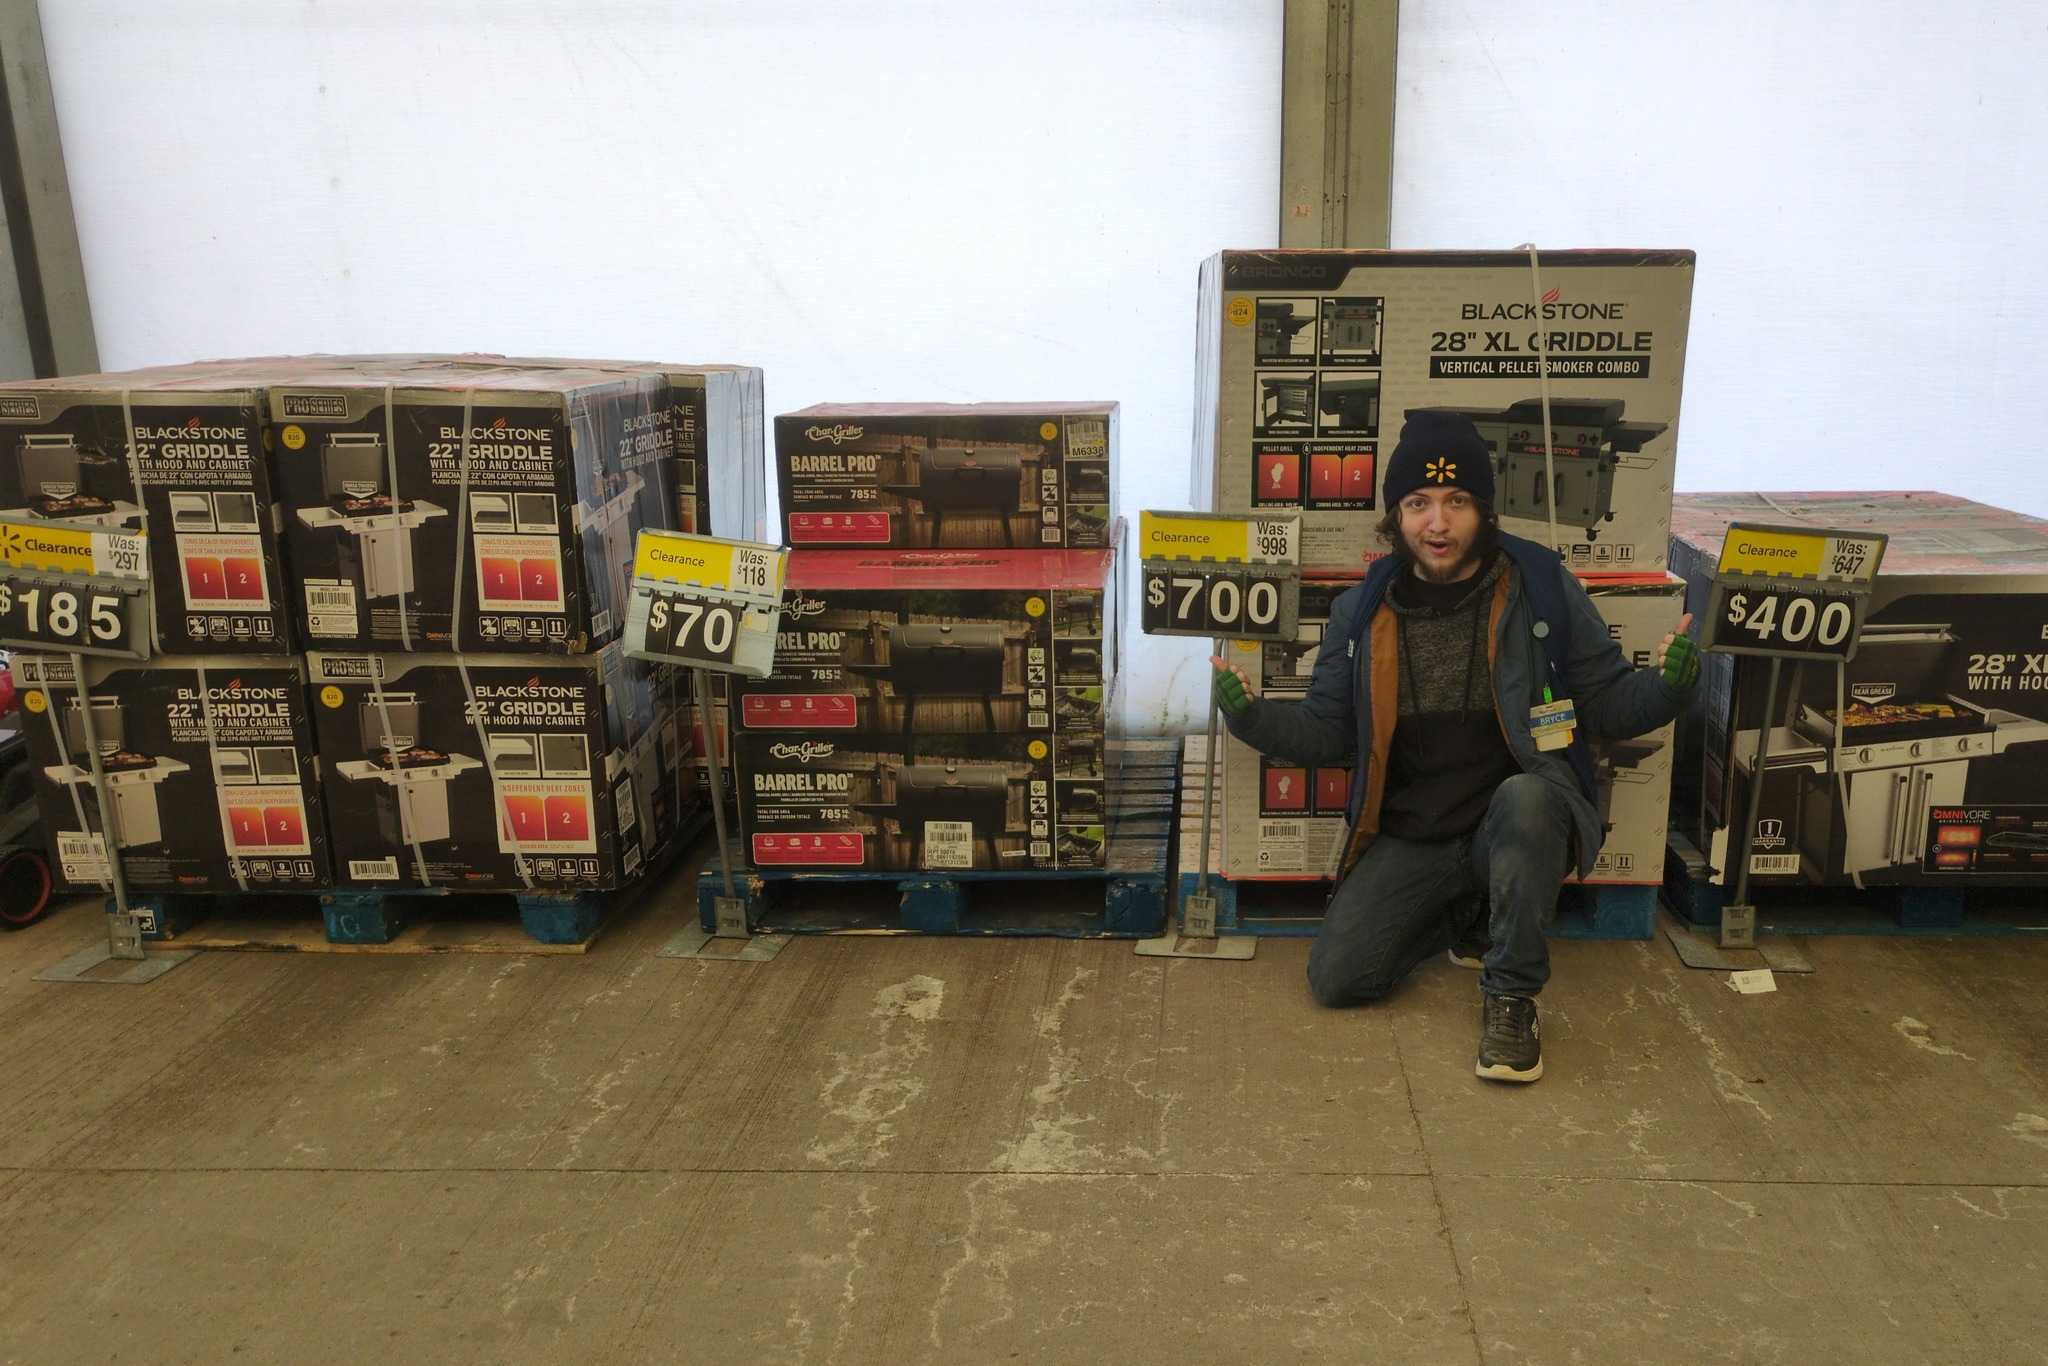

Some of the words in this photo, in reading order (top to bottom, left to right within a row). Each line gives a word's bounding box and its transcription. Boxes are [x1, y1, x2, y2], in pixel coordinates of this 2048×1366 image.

[1242, 266, 1326, 278] BRONCO
[1461, 303, 1624, 320] BLACKSTONE
[1431, 331, 1477, 351] 28"
[1484, 332, 1520, 351] XL
[1528, 332, 1653, 352] GRIDDLE
[1440, 361, 1495, 374] VERTICAL
[1498, 361, 1541, 374] PELLET
[1546, 361, 1593, 374] SMOKER
[1597, 361, 1640, 374] COMBO
[2, 400, 37, 418] SERIES
[286, 400, 309, 414] PRO
[310, 400, 344, 414] SERIES
[624, 410, 671, 432] BLACKSTONE
[135, 427, 247, 440] BLACKSTONE
[635, 428, 673, 453] GRIDDLE
[805, 424, 864, 445] Char-Griller
[125, 444, 156, 458] 22"
[162, 444, 249, 459] GRIDDLE
[428, 443, 460, 458] 22"
[468, 444, 553, 460] GRIDDLE
[1531, 446, 1580, 456] BLACSTONE
[127, 460, 152, 469] WTH
[156, 460, 183, 469] HOOD
[186, 460, 206, 470] AND
[209, 460, 250, 470] CABINET
[430, 459, 455, 469] WITH
[489, 460, 509, 470] AND
[512, 461, 554, 471] CABINET
[791, 456, 846, 472] BARREL
[224, 472, 252, 480] ARMARIO
[1324, 470, 1329, 480] 1
[1354, 470, 1360, 480] 2
[850, 490, 870, 499] 785
[1152, 531, 1210, 544] Clearance
[1257, 522, 1288, 536] Was:
[25, 538, 92, 556] Clearance
[108, 535, 139, 551] Was:
[1257, 537, 1287, 556] $998
[1600, 547, 1606, 555] 6
[1738, 543, 1798, 558] Clearance
[1836, 540, 1868, 555] Was:
[108, 552, 139, 571] $297
[650, 549, 705, 567] Clearance
[740, 549, 768, 566] Was:
[1832, 555, 1864, 575] $647
[203, 573, 208, 584] 1
[240, 573, 247, 584] 2
[499, 573, 504, 584] 1
[536, 574, 543, 585] 2
[737, 565, 766, 587] $118
[1148, 577, 1278, 625] $700
[238, 620, 244, 628] 9
[531, 621, 537, 629] 9
[650, 599, 733, 654] $70
[1728, 593, 1851, 646] $400
[324, 661, 348, 675] PRO
[348, 661, 381, 676] SERIS
[1968, 654, 2016, 674] 28"
[50, 665, 76, 680] SERIE
[812, 670, 833, 680] 785
[1968, 676, 2012, 690] WITH
[475, 686, 584, 698] BLACKSTONE
[168, 704, 198, 718] 22"
[210, 703, 290, 717] GRIDDLE
[464, 702, 495, 715] 22"
[500, 702, 586, 716] GRIDDLE
[170, 718, 195, 727] WITH
[227, 718, 245, 727] AND
[250, 718, 291, 727] CABINET
[466, 716, 490, 725] WTH
[494, 716, 520, 725] HOOD
[523, 716, 542, 725] AND
[546, 716, 586, 726] CABINET
[1540, 713, 1566, 726] BRYCE
[770, 742, 834, 763] Char-Griller
[754, 774, 815, 791] BARREL
[521, 812, 526, 824] 1
[563, 812, 571, 824] 2
[820, 809, 841, 819] 785
[1934, 809, 1990, 820] OMNIVORE
[244, 821, 249, 832] 1
[280, 821, 288, 831] 2
